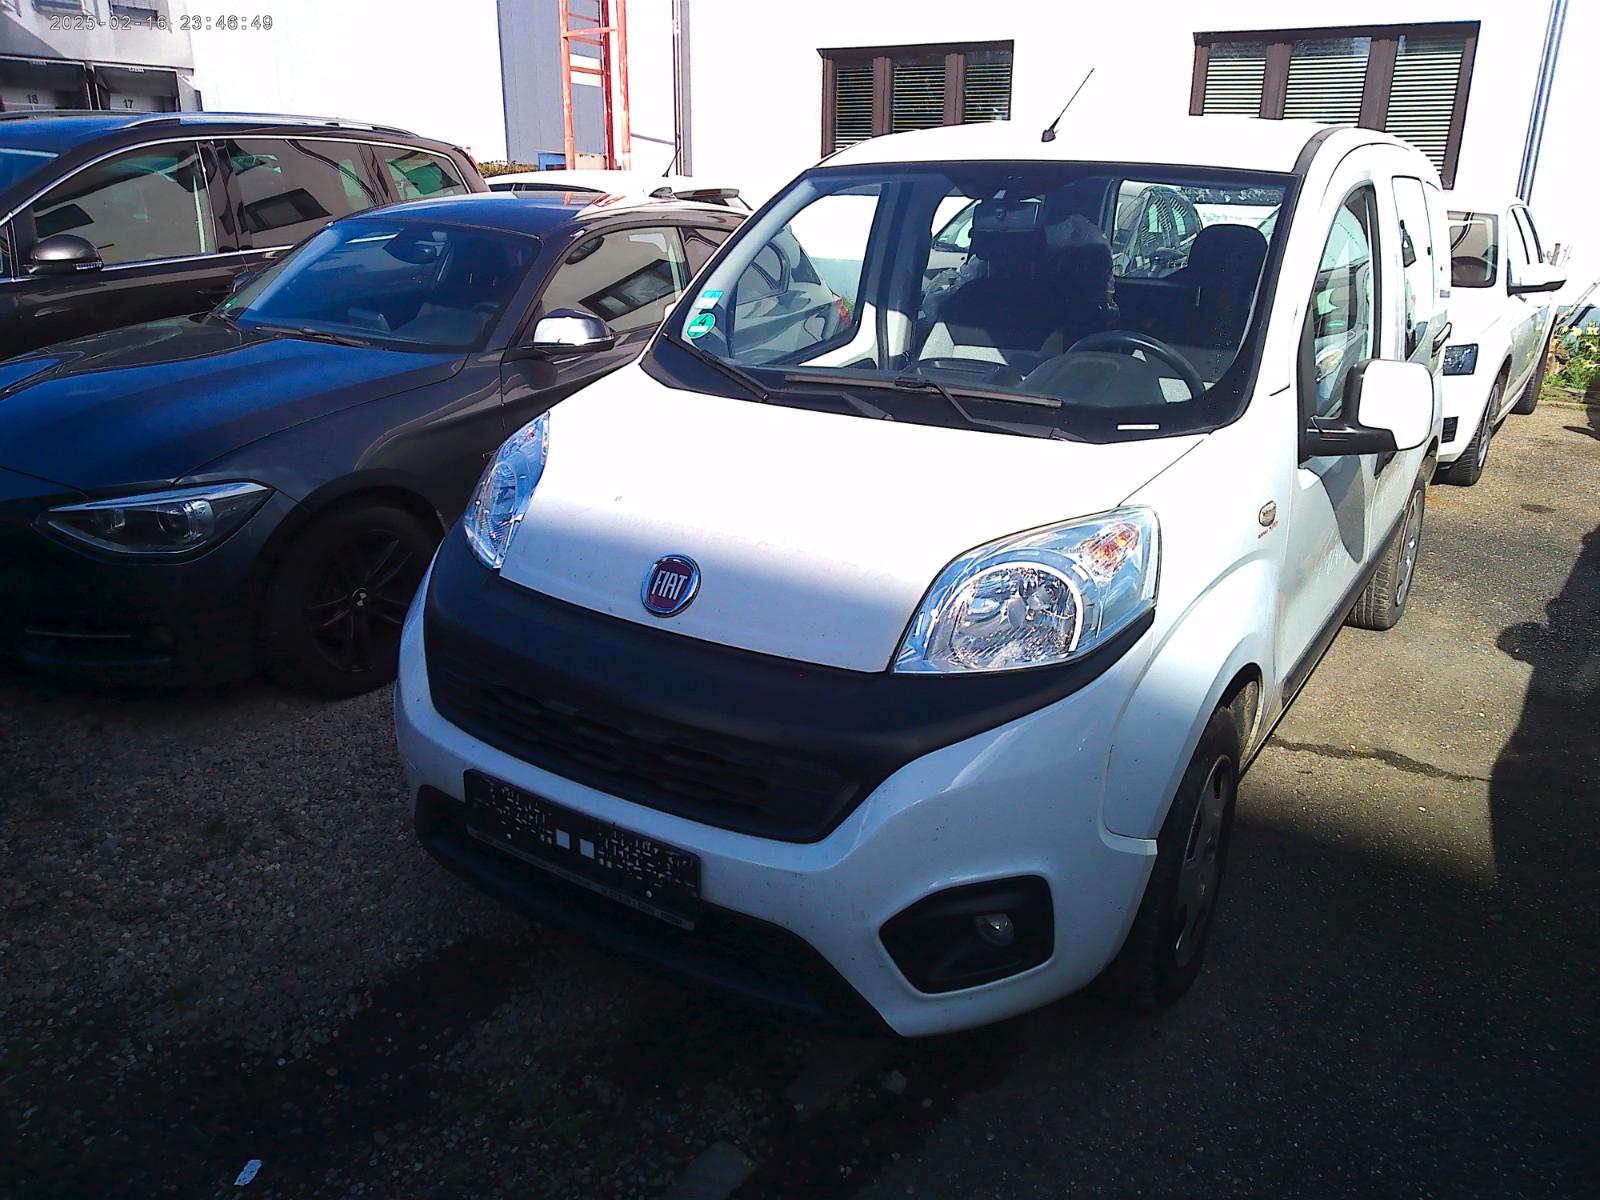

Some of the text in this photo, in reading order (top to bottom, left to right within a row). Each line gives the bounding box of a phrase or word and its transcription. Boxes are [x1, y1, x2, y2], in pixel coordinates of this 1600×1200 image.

[26, 93, 39, 105] 18
[123, 98, 134, 109] 17
[651, 569, 688, 600] FIAT
